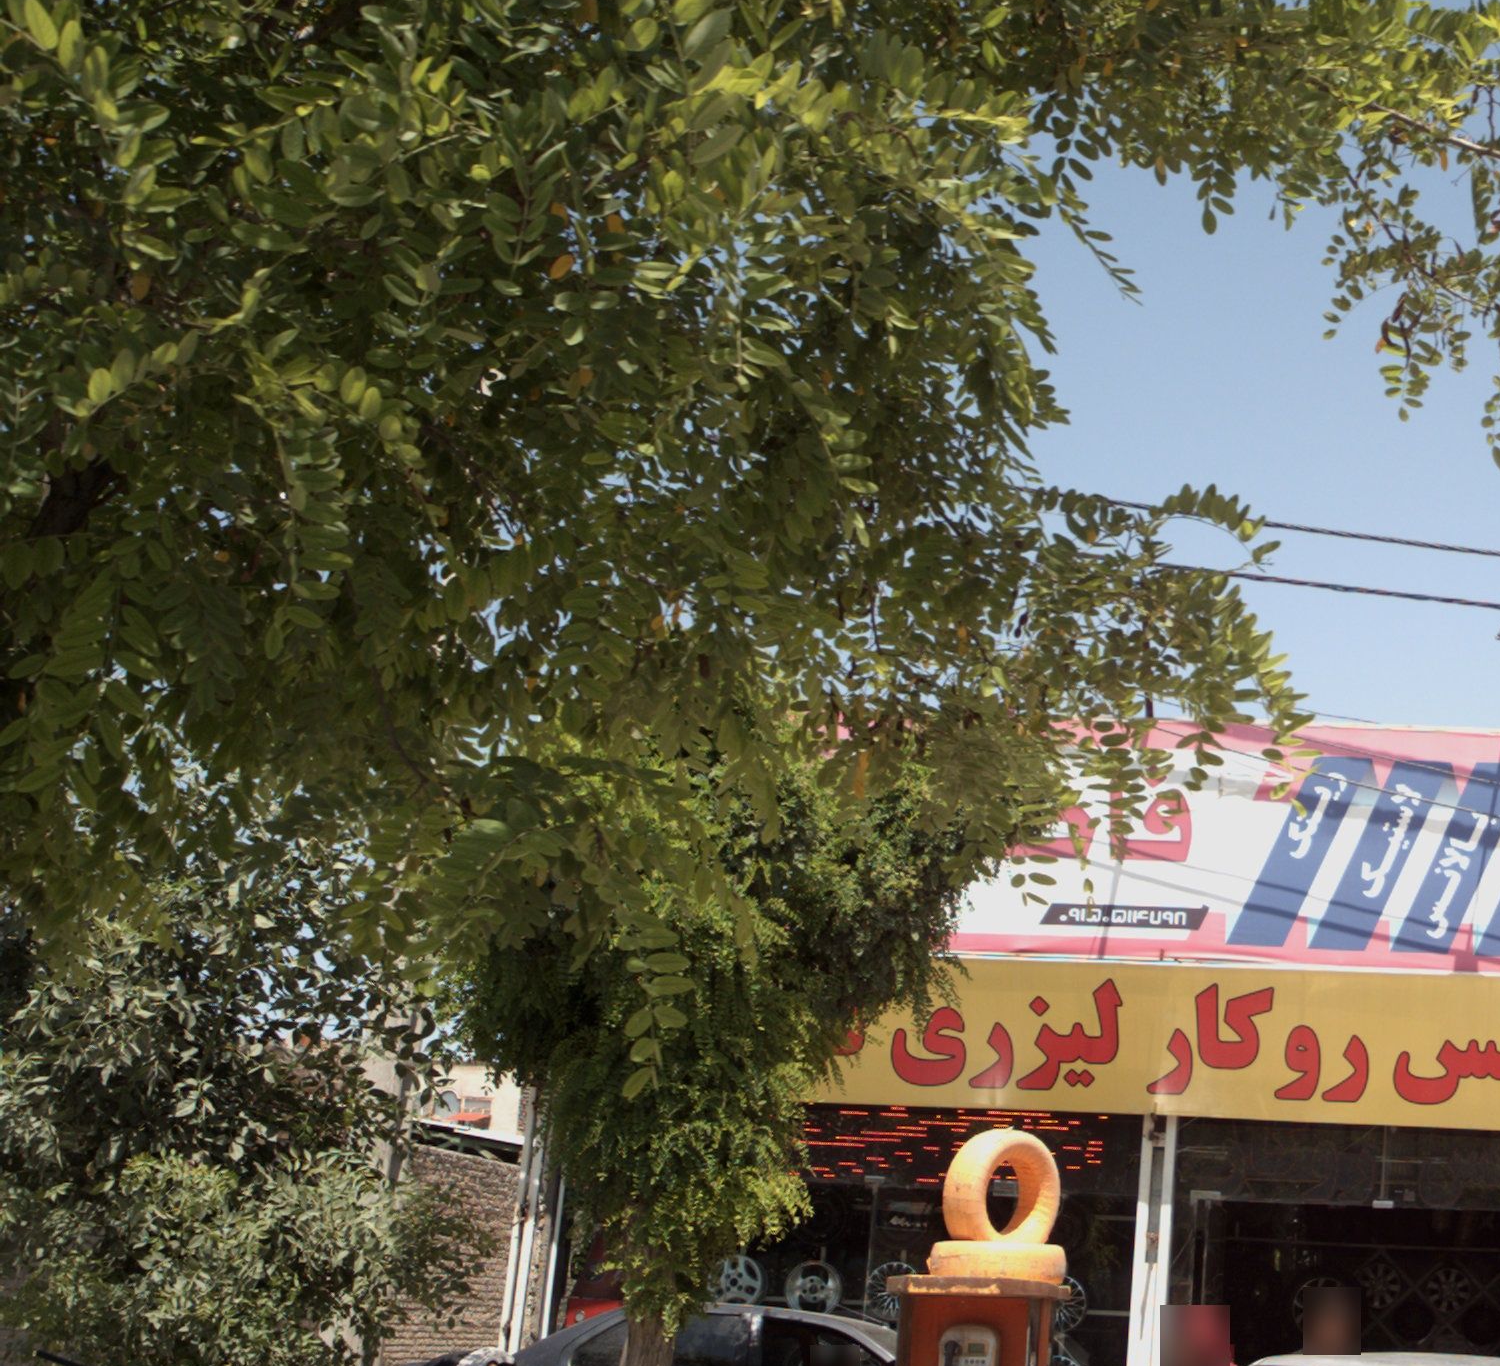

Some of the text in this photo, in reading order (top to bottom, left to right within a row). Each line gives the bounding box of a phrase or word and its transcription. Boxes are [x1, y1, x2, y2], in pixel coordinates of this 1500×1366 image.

[1361, 783, 1422, 898] لاستیک
[1425, 811, 1497, 939] بالانس
[890, 978, 1124, 1091] لیزری
